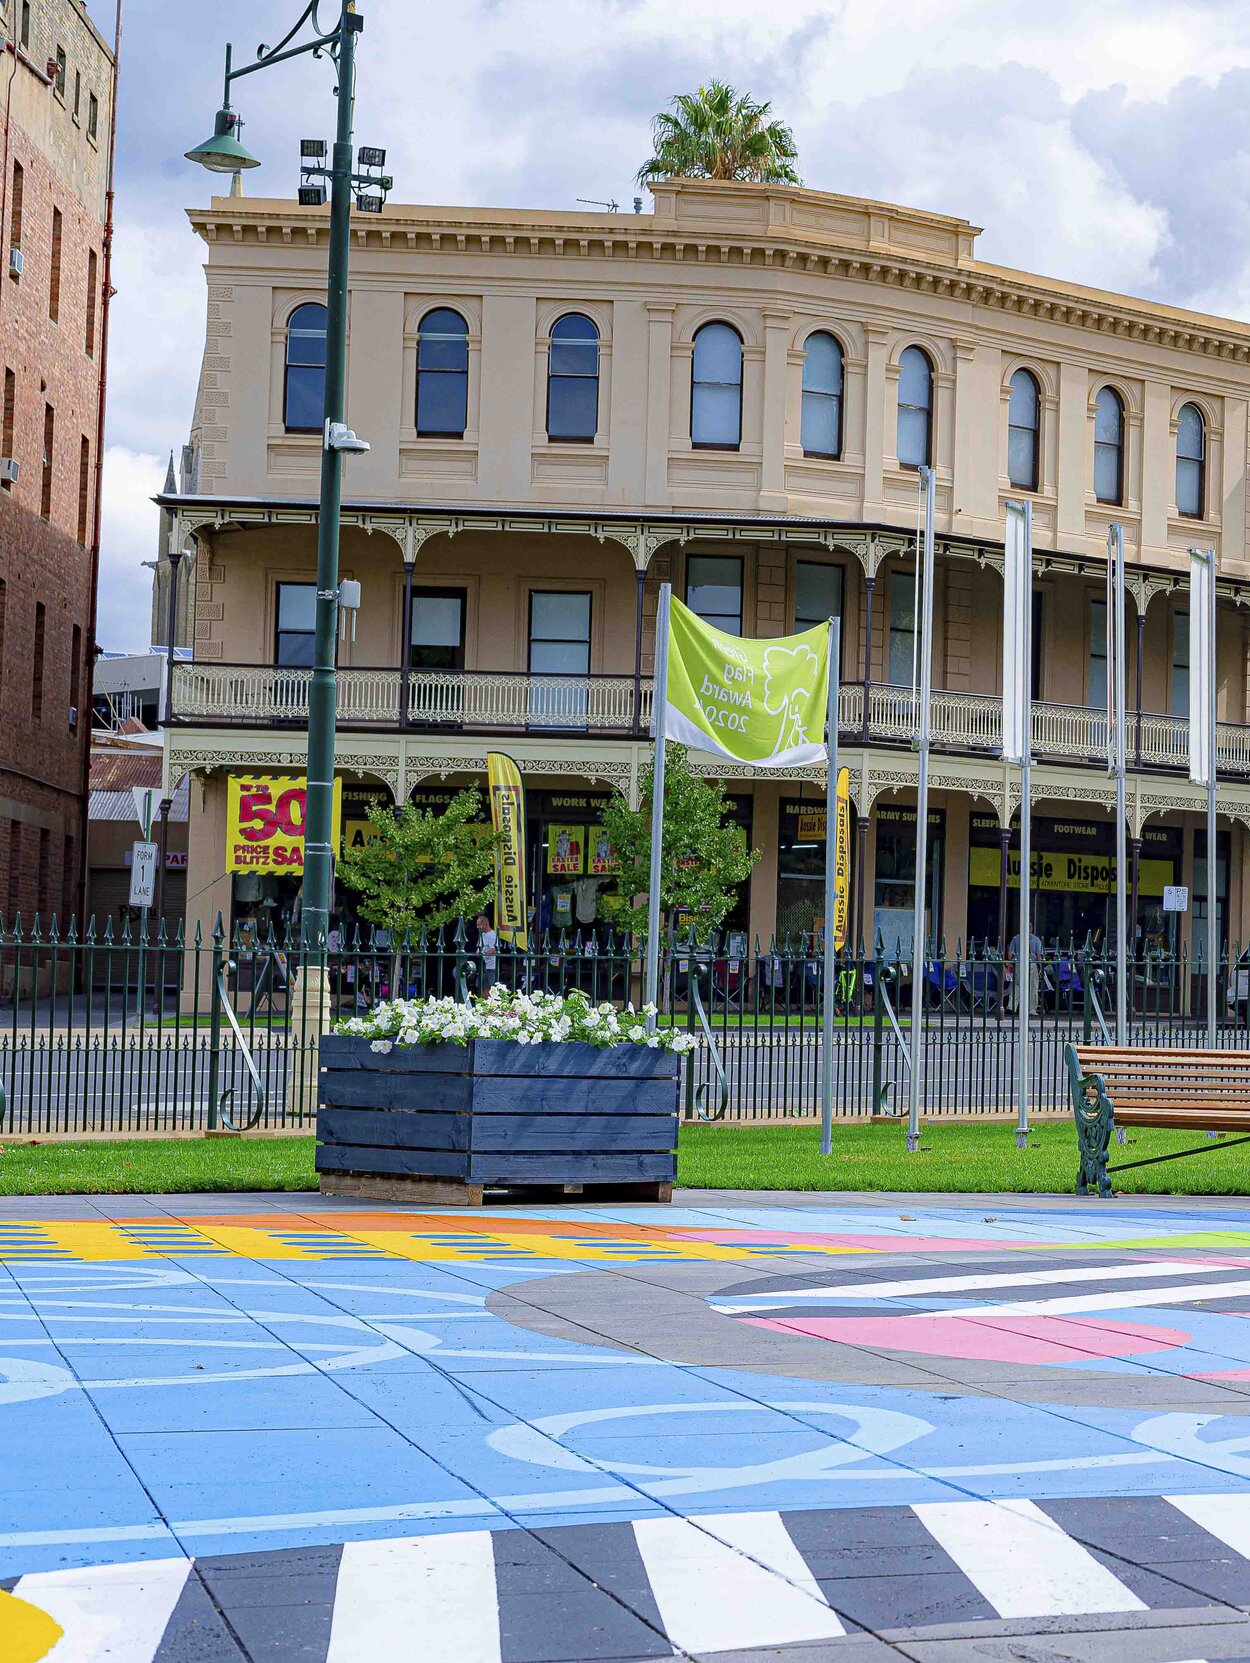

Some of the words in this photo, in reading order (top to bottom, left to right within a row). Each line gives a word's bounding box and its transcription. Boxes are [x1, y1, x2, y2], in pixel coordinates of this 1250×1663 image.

[240, 784, 253, 792] UP
[255, 784, 270, 792] TO
[342, 790, 388, 801] FISHING
[415, 794, 450, 804] FLAGS
[551, 797, 587, 807] WORK
[239, 787, 306, 842] 50
[786, 804, 827, 815] HARDW
[876, 810, 900, 821] ARMY
[901, 812, 941, 823] SUPIES
[1053, 824, 1097, 836] FOOTWEAR
[836, 805, 847, 878] Disposals
[1145, 831, 1168, 841] WEAR
[234, 844, 270, 854] PRICE
[136, 850, 153, 861] FORM
[234, 855, 270, 866] BLITZ
[272, 846, 305, 867] SA
[141, 864, 145, 882] 1
[552, 863, 580, 873] SALE
[133, 886, 150, 897] LANE
[836, 886, 845, 933] Aussie
